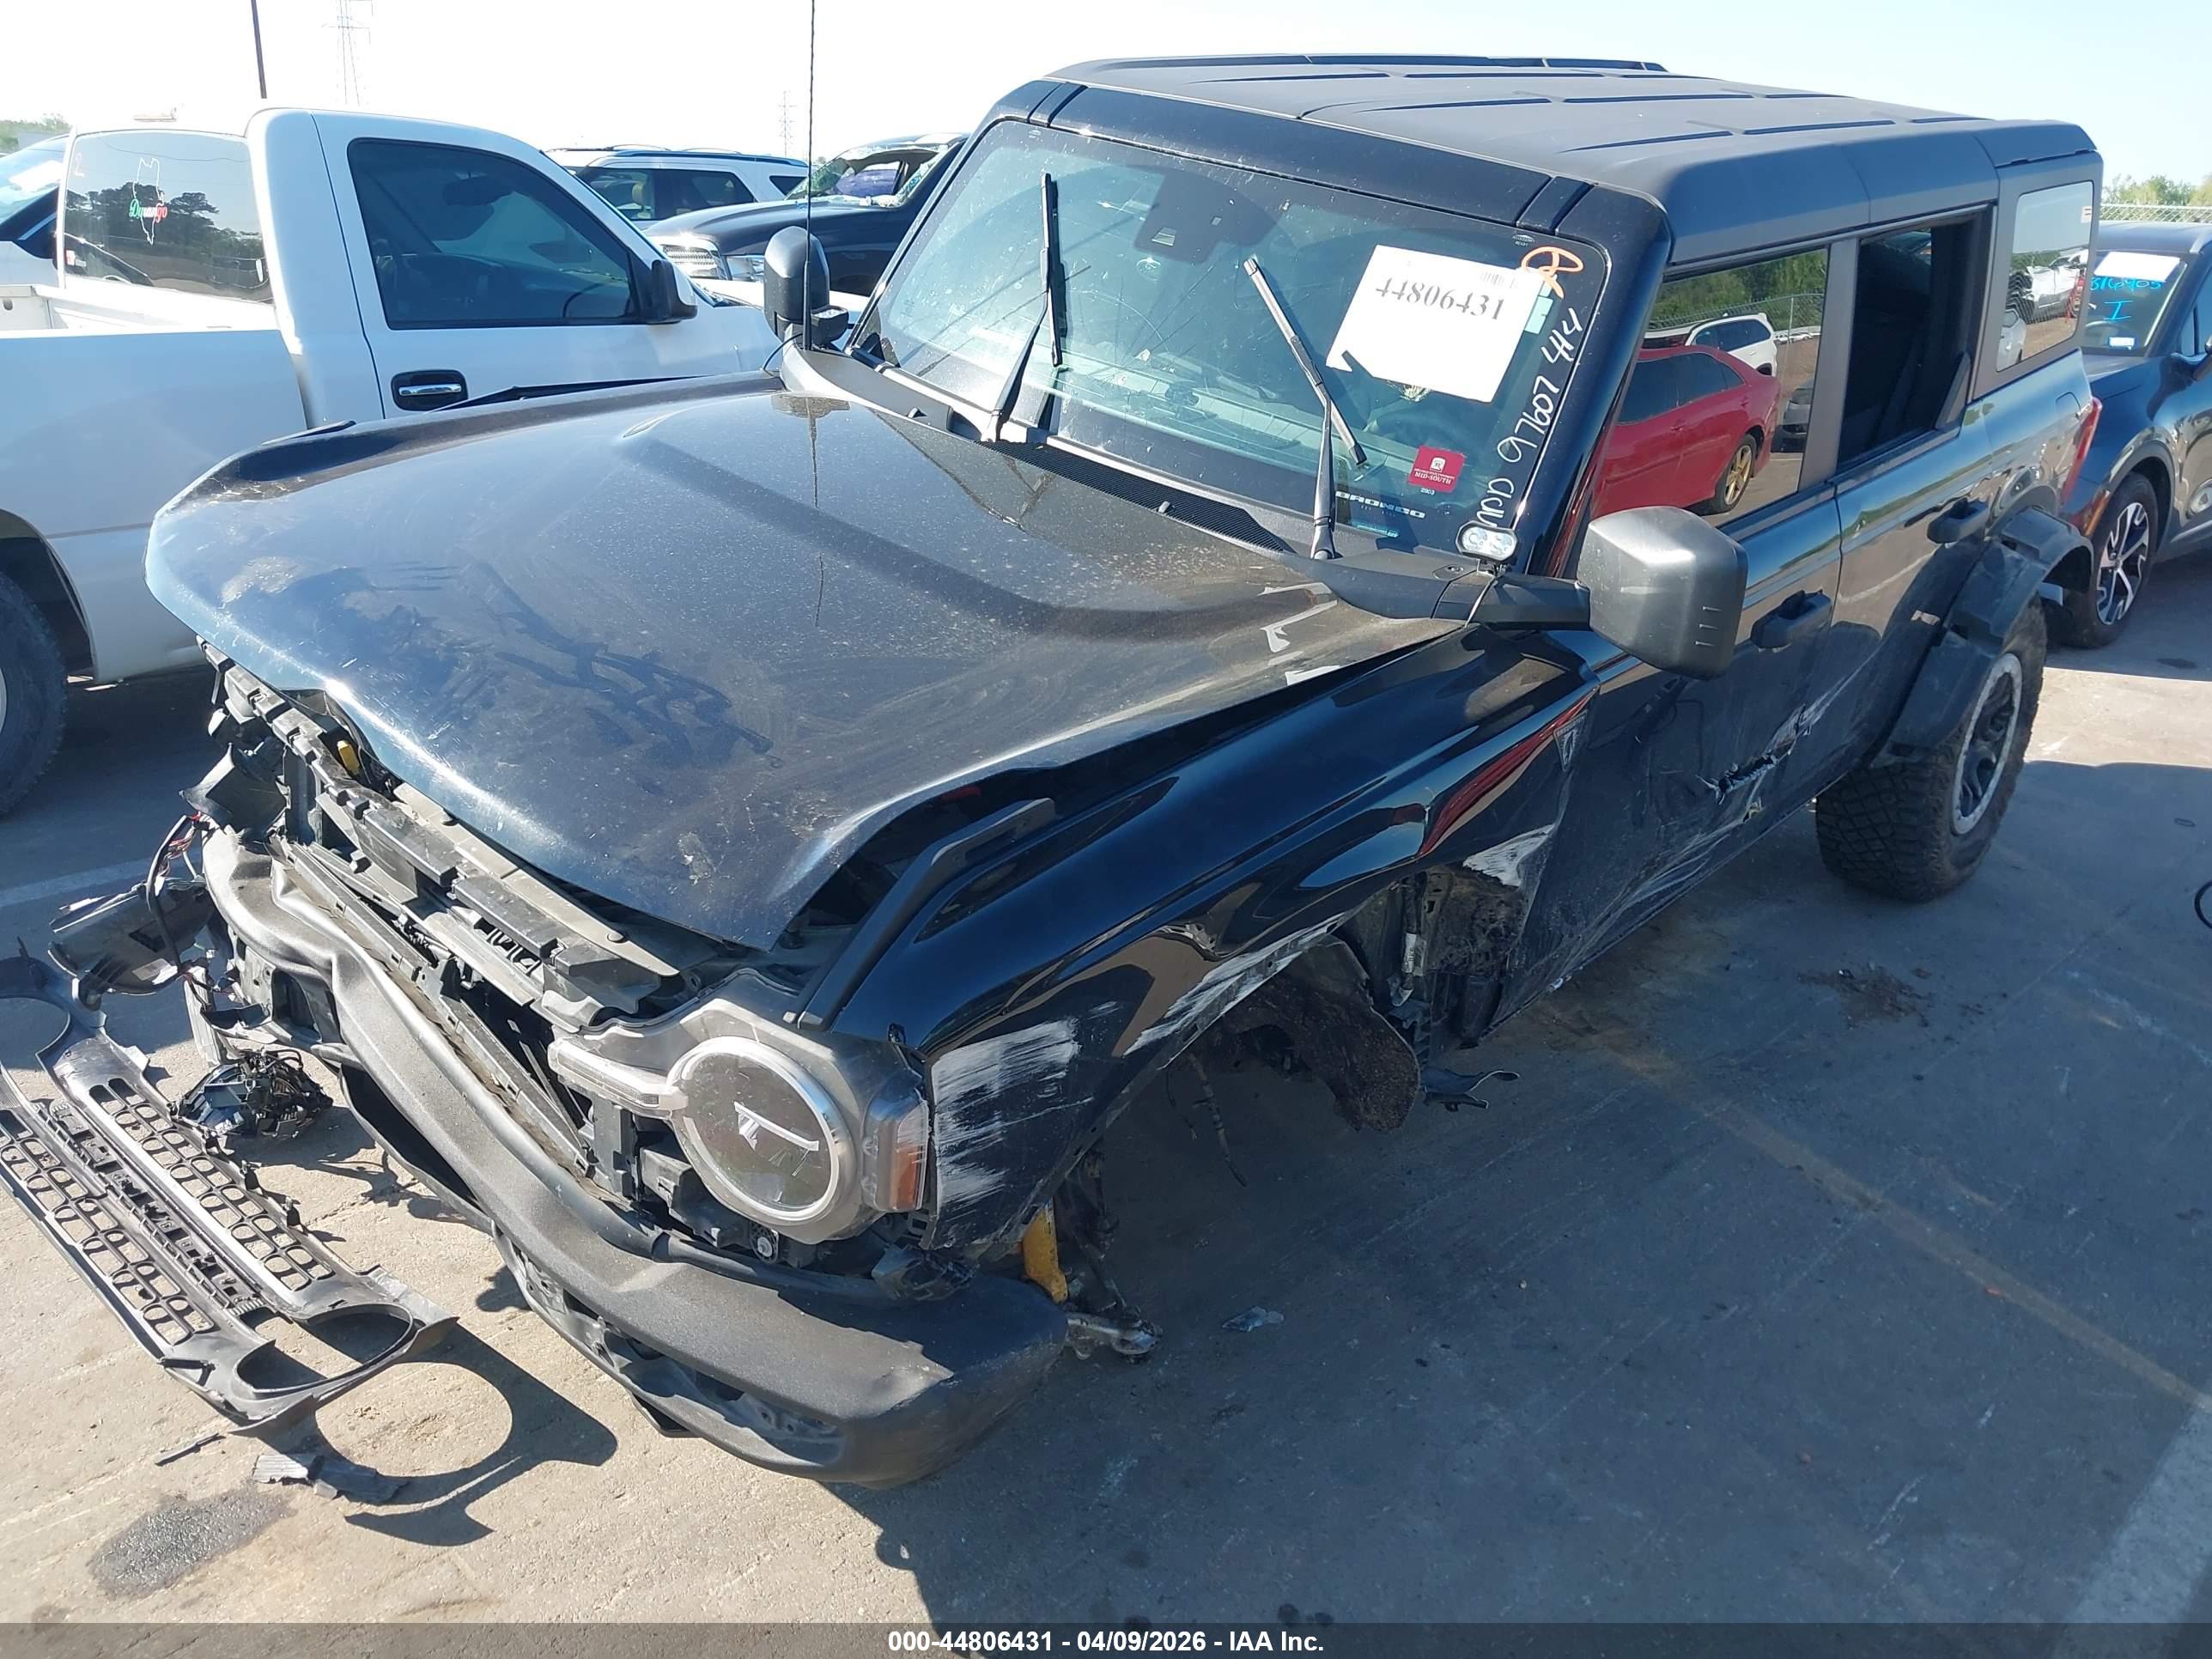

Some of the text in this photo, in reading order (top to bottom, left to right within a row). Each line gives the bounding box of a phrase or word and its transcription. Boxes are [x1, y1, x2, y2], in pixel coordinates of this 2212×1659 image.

[1376, 277, 1504, 320] 44806431
[1414, 471, 1452, 484] MID-SOUTH
[1335, 490, 1425, 519] BRONCO
